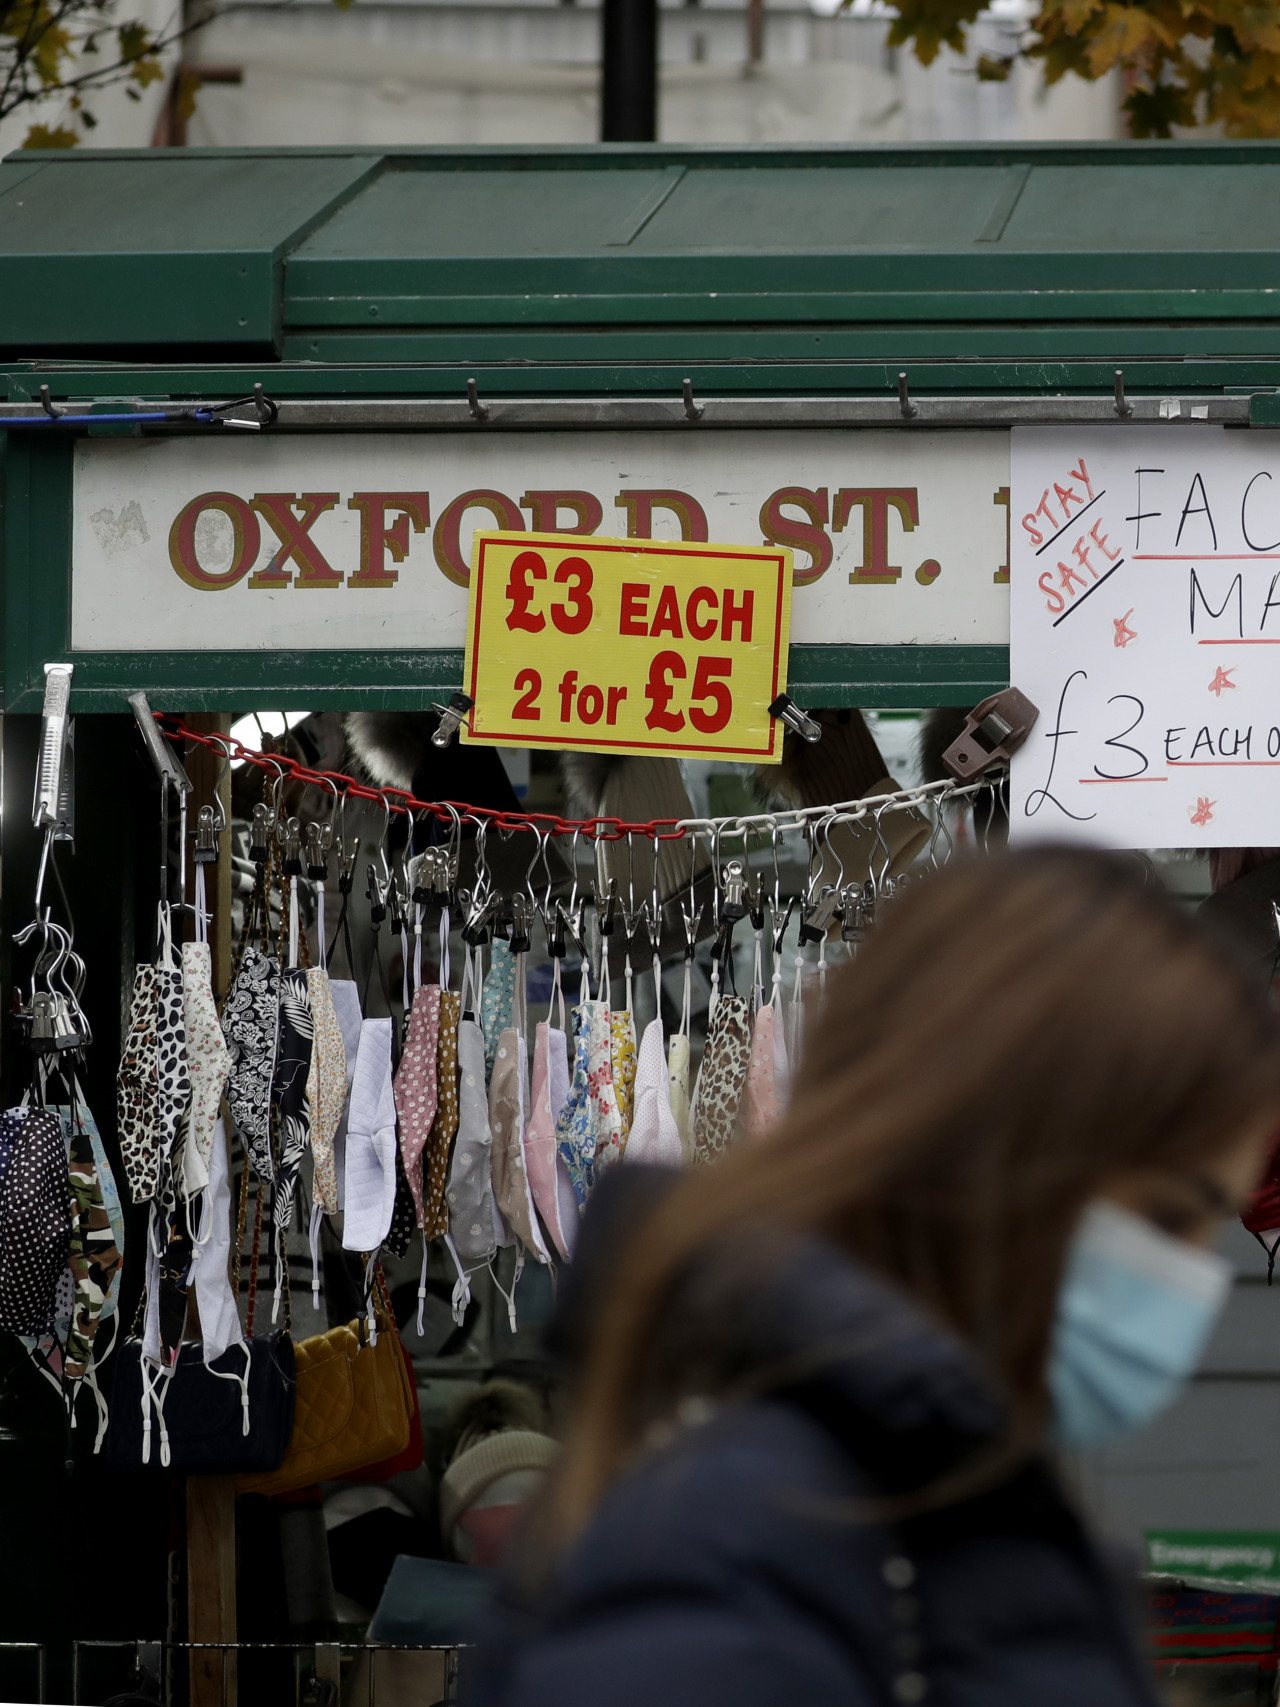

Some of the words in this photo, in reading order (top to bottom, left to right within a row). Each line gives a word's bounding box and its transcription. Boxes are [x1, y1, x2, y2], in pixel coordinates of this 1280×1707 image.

[759, 486, 942, 588] ST.
[1021, 457, 1094, 547] STAY
[505, 550, 595, 635] £3
[618, 581, 755, 643] EACH
[1038, 516, 1123, 614] SAFE
[511, 668, 542, 721] 2
[558, 669, 627, 726] for
[645, 649, 733, 735] £5
[1025, 670, 1149, 821] £3
[1164, 725, 1253, 761] EACH
